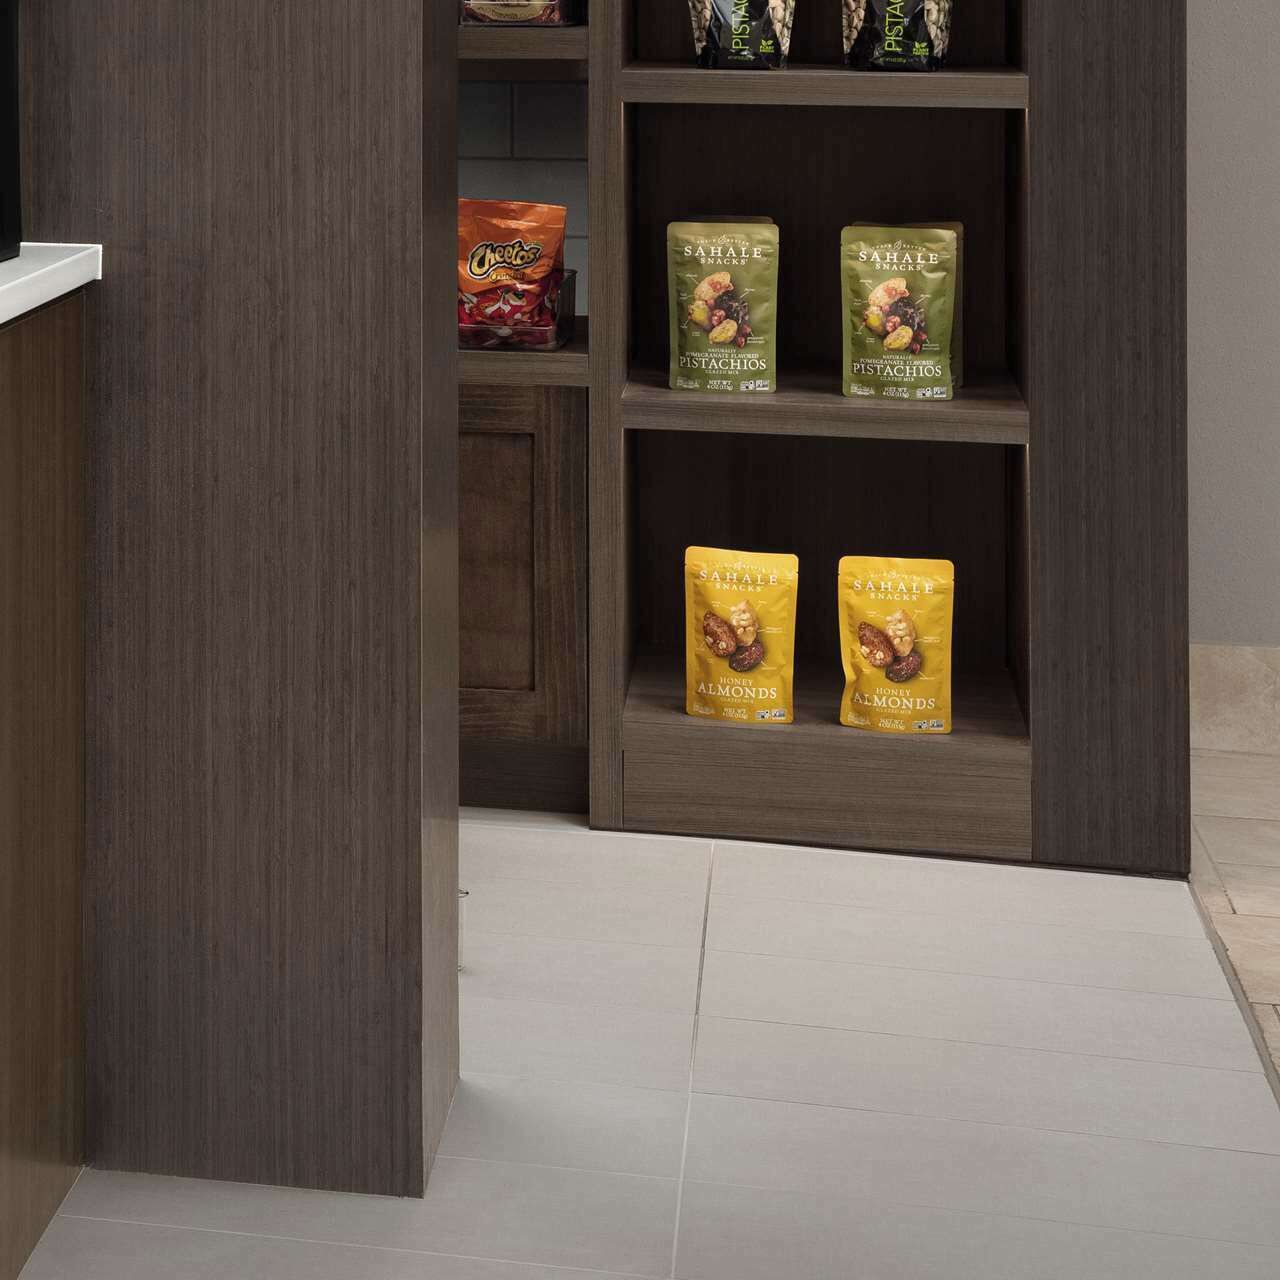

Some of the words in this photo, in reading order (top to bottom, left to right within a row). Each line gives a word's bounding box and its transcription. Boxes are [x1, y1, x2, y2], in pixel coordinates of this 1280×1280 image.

[684, 245, 762, 258] SAHALE
[858, 250, 939, 264] SAHALE
[469, 241, 541, 277] Cheetos
[875, 263, 924, 271] SNACKS
[679, 357, 767, 370] PISTACHIOS
[853, 363, 942, 377] PISTACHIOS
[699, 569, 778, 585] SAHALE
[853, 580, 934, 593] SAHALE
[870, 593, 919, 601] SNACKS
[719, 676, 753, 687] HONEY
[697, 681, 777, 700] ALMONDS
[876, 687, 911, 696] HONEY
[853, 692, 936, 710] ALMONDS
